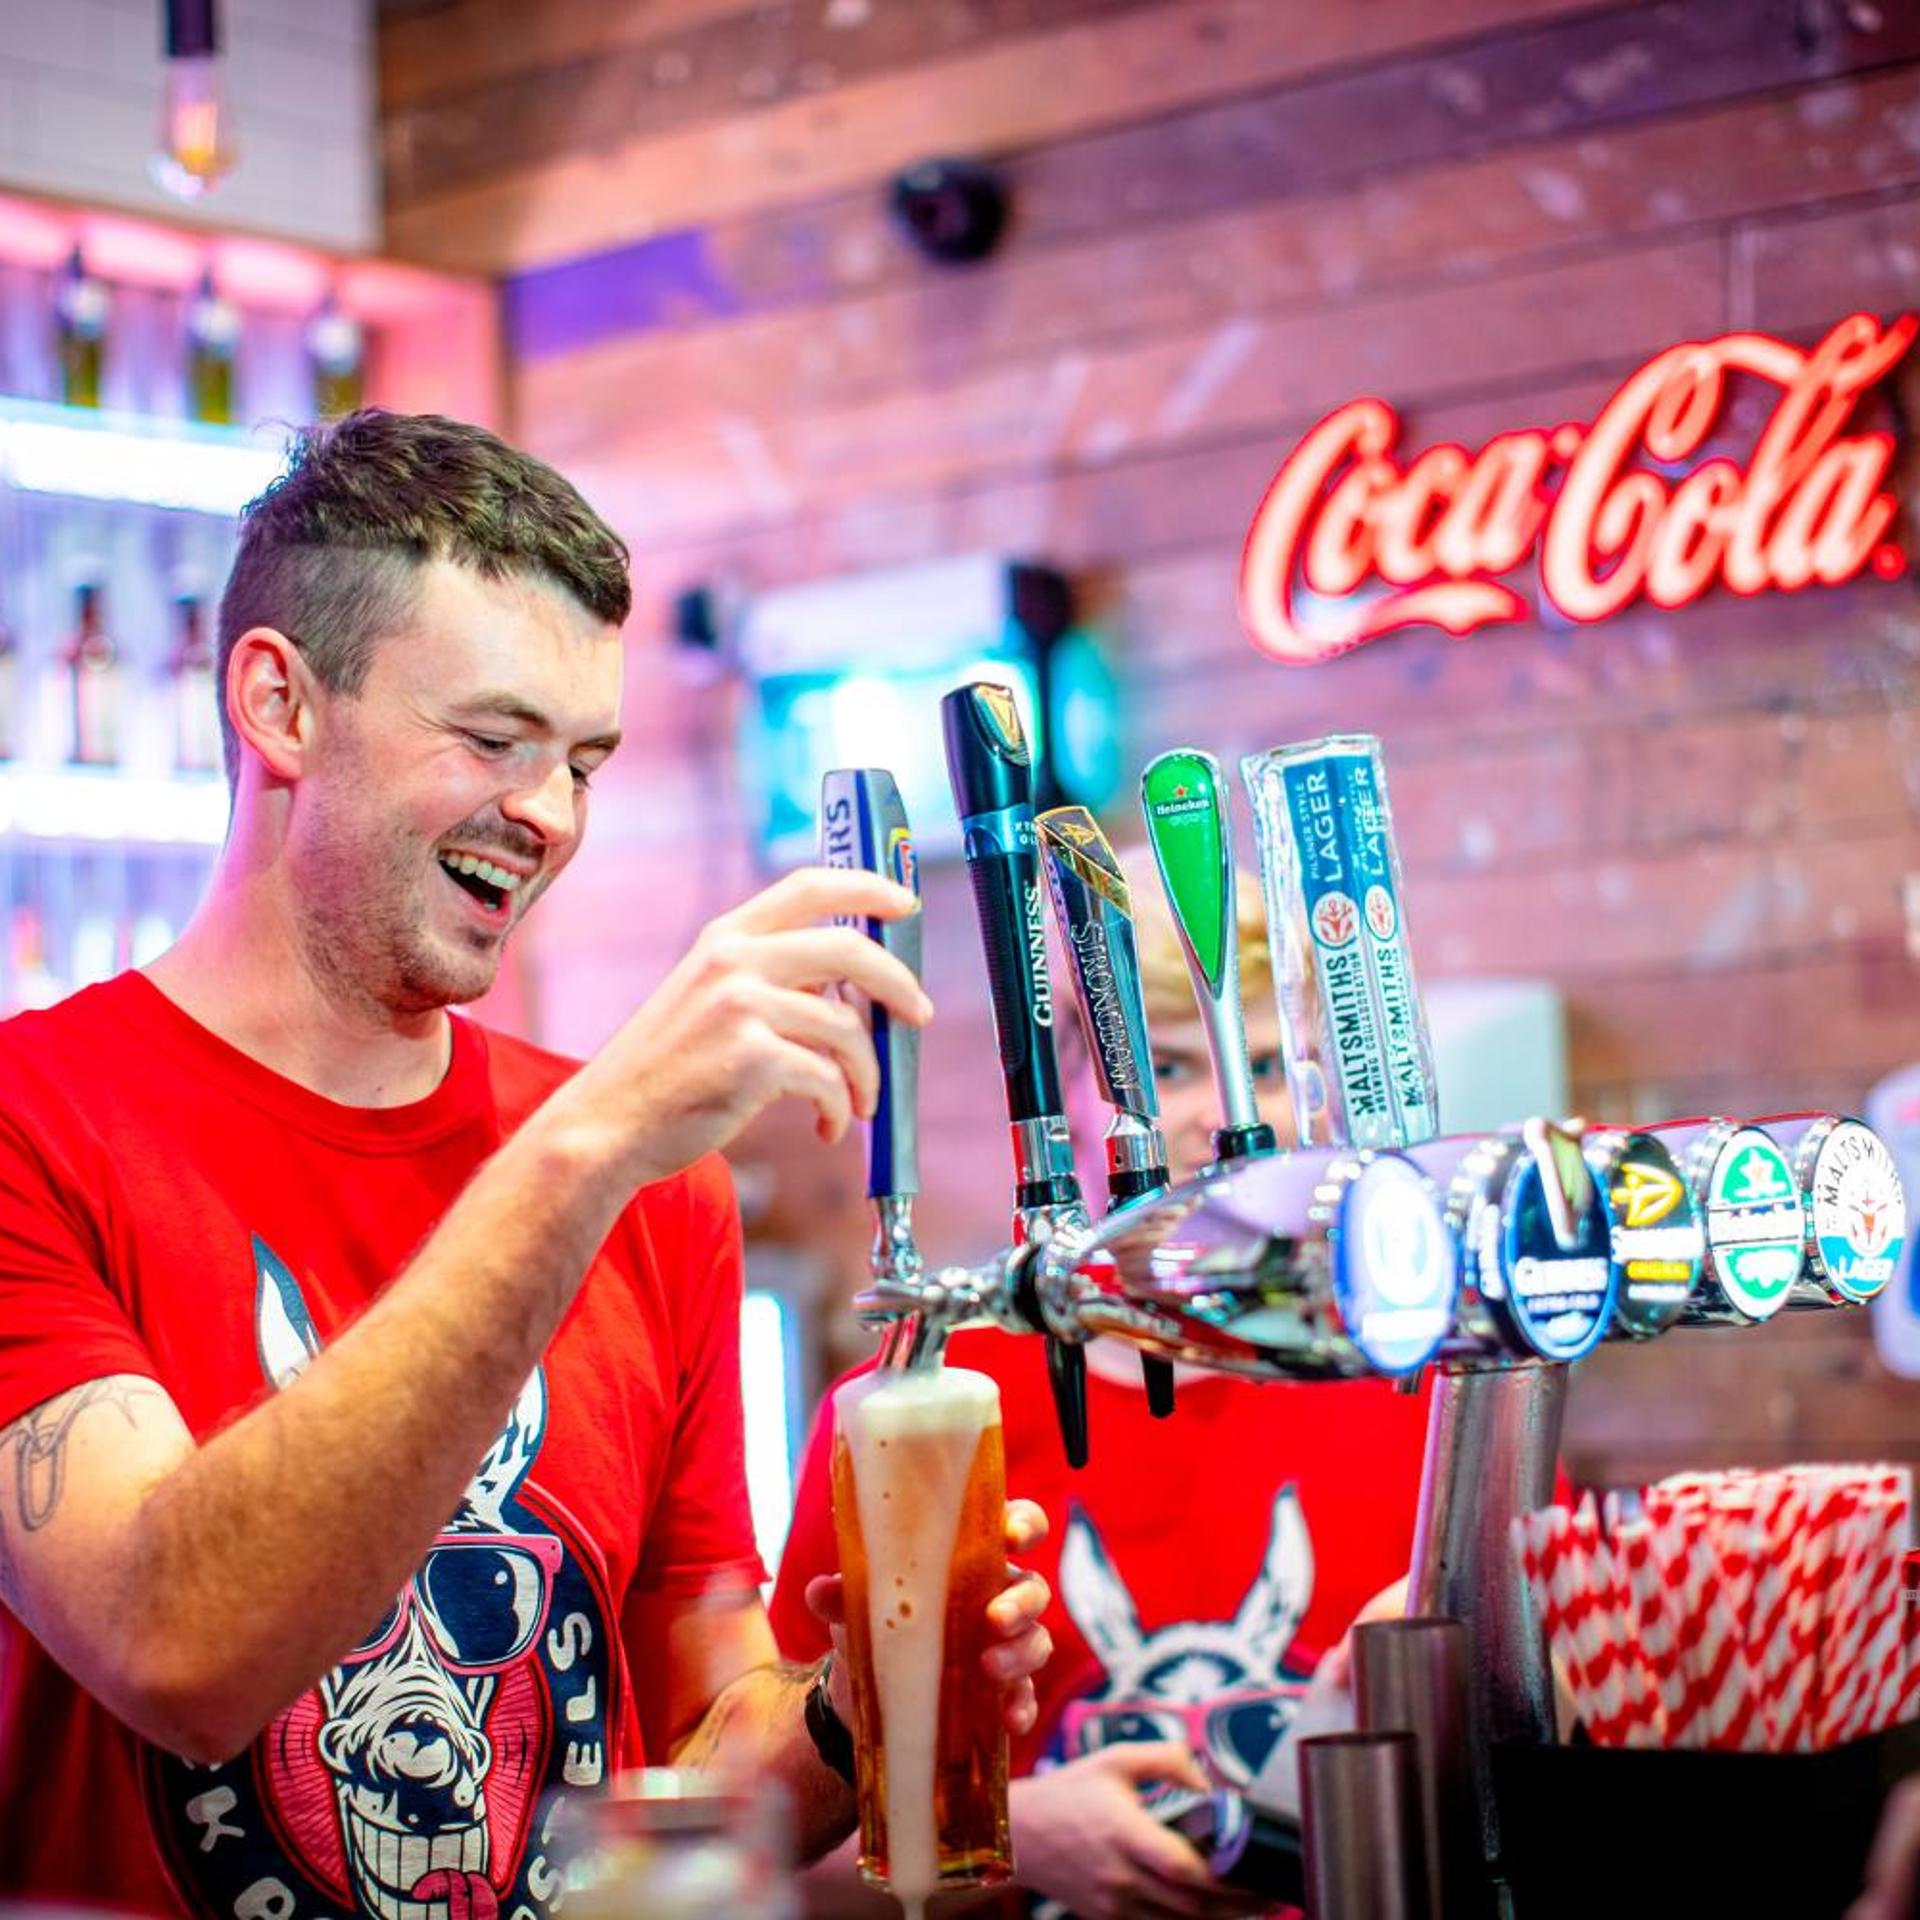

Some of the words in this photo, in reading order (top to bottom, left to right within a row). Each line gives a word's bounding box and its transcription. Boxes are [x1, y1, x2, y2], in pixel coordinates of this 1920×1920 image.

[1156, 799, 1210, 815] Heineken
[1306, 771, 1343, 882] LAGER
[1025, 884, 1054, 1028] GUINNESS
[1326, 955, 1375, 1117] MALTSMITHS
